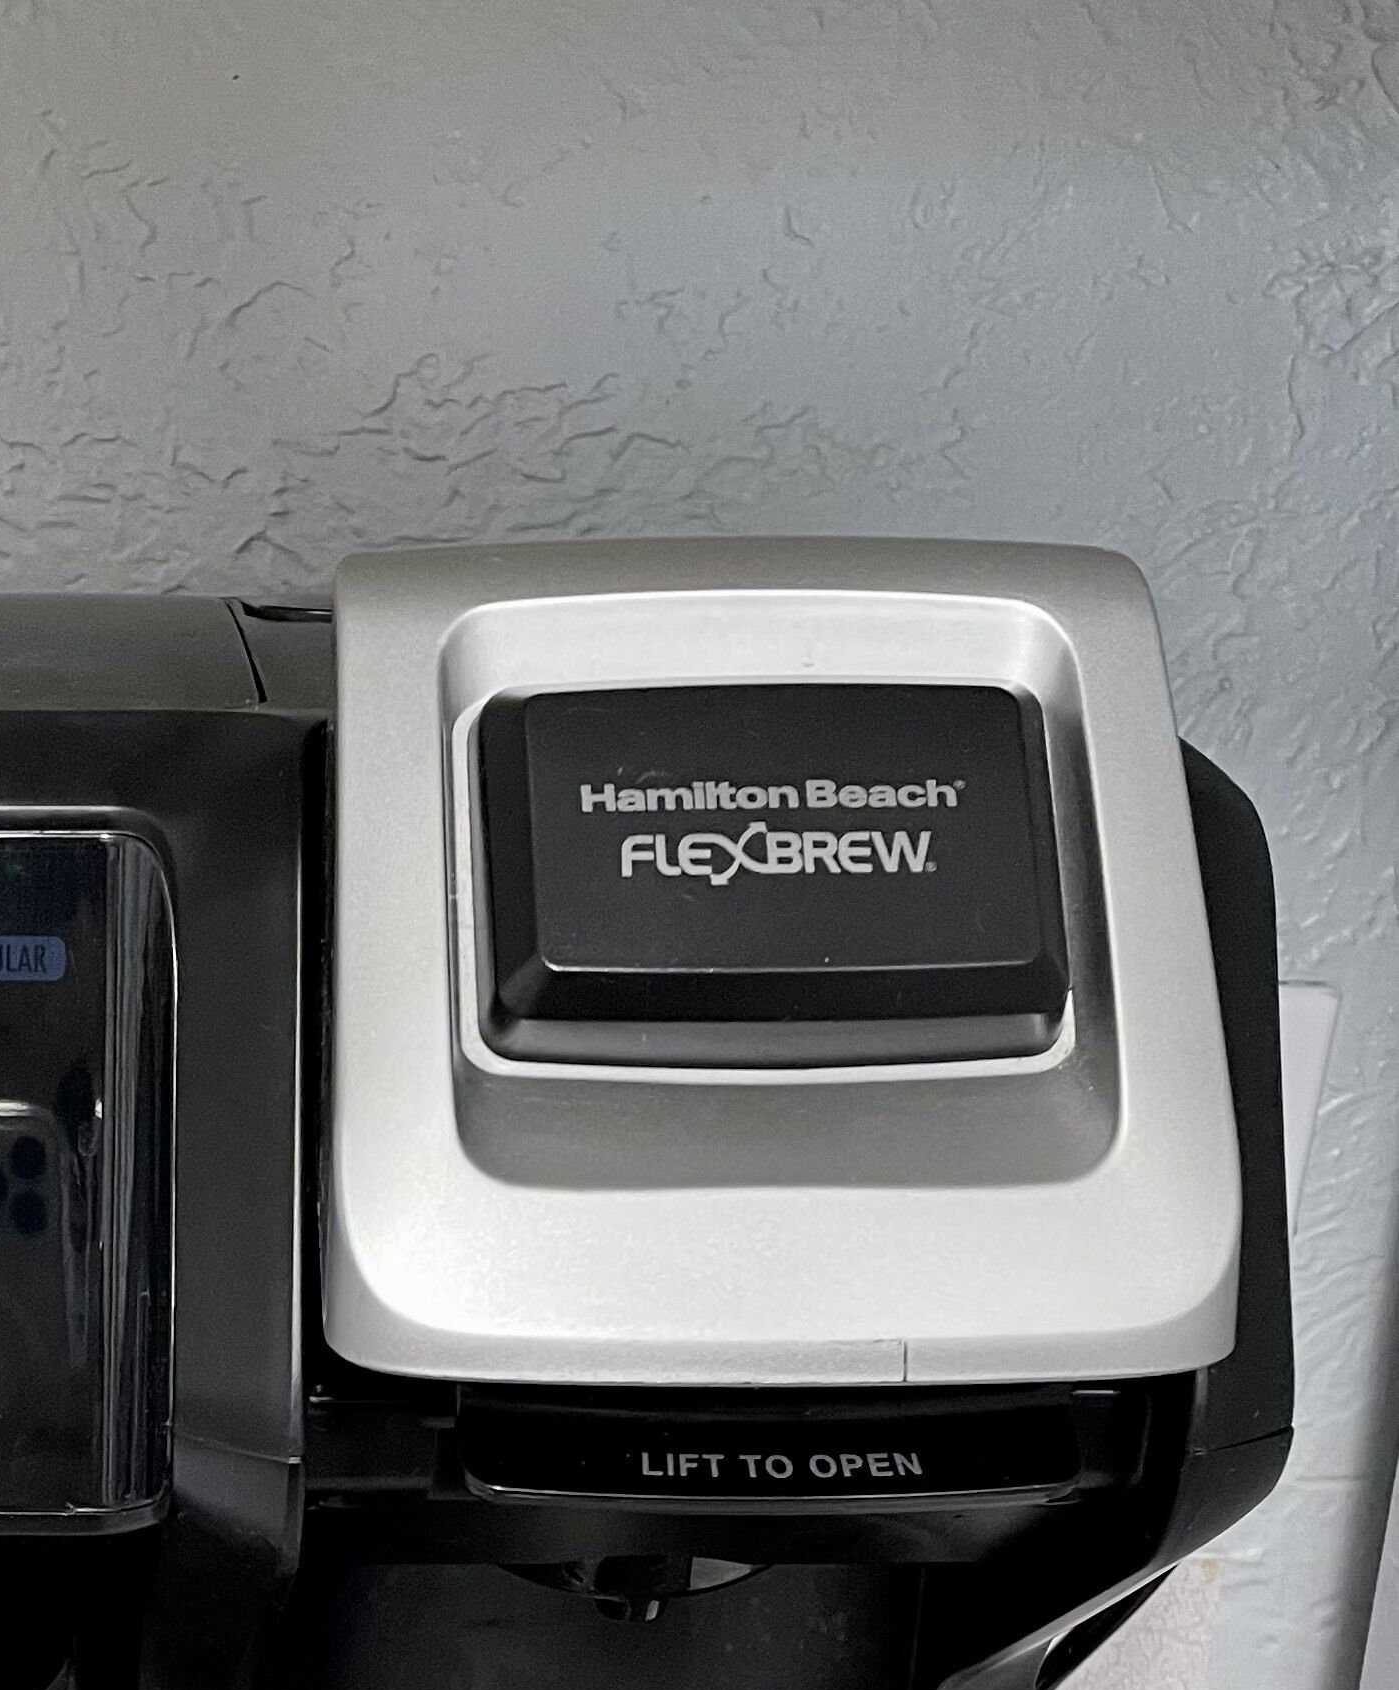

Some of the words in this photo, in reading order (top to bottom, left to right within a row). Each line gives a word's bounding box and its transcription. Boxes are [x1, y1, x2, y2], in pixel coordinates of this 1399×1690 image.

[580, 780, 800, 813] Hamilton
[804, 778, 959, 809] Beach
[620, 821, 932, 886] FLEXBREW
[641, 1452, 725, 1478] LIFT
[739, 1454, 794, 1479] TO
[809, 1453, 923, 1479] OPEN
